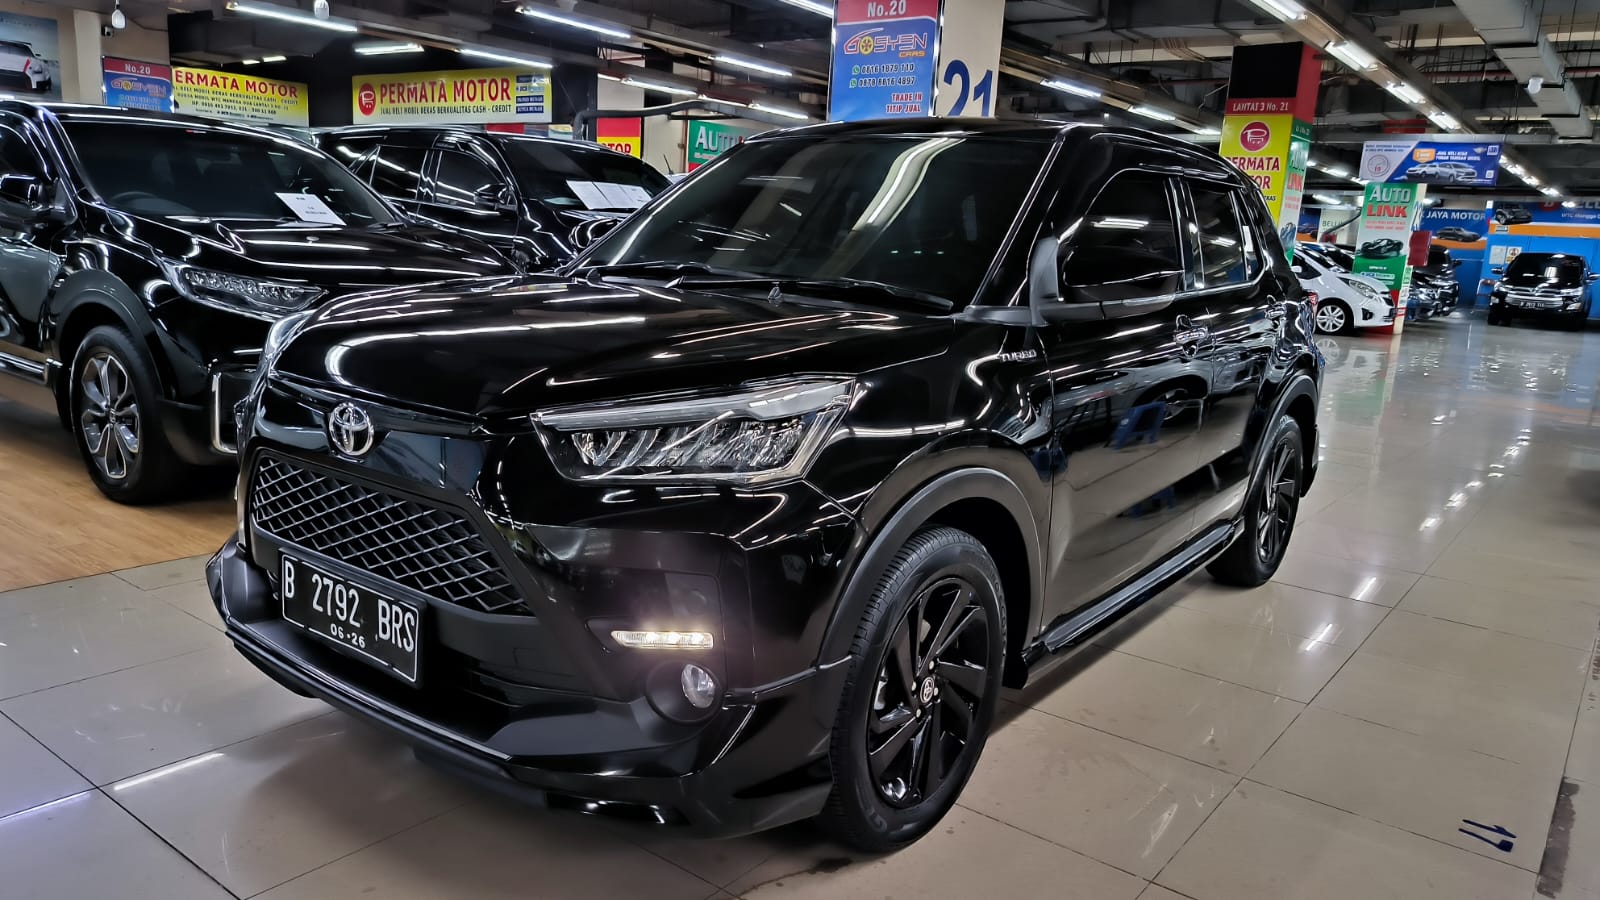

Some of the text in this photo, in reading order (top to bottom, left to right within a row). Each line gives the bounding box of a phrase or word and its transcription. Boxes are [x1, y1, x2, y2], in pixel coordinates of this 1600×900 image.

[867, 0, 906, 18] No.20
[844, 28, 927, 54] GOSYEN
[125, 63, 150, 74] No.20
[245, 79, 298, 98] MOTOR
[380, 77, 511, 104] PERMATA MOTOR
[943, 59, 992, 116] 21
[491, 104, 512, 112] CREDIT
[1232, 101, 1259, 111] LANTAI
[1279, 102, 1288, 111] 21
[1369, 186, 1411, 203] AUTO
[1367, 204, 1407, 218] LINK
[1426, 210, 1448, 219] JAYA
[1000, 349, 1037, 362] TURBO
[284, 560, 415, 652] B 2792 BRS
